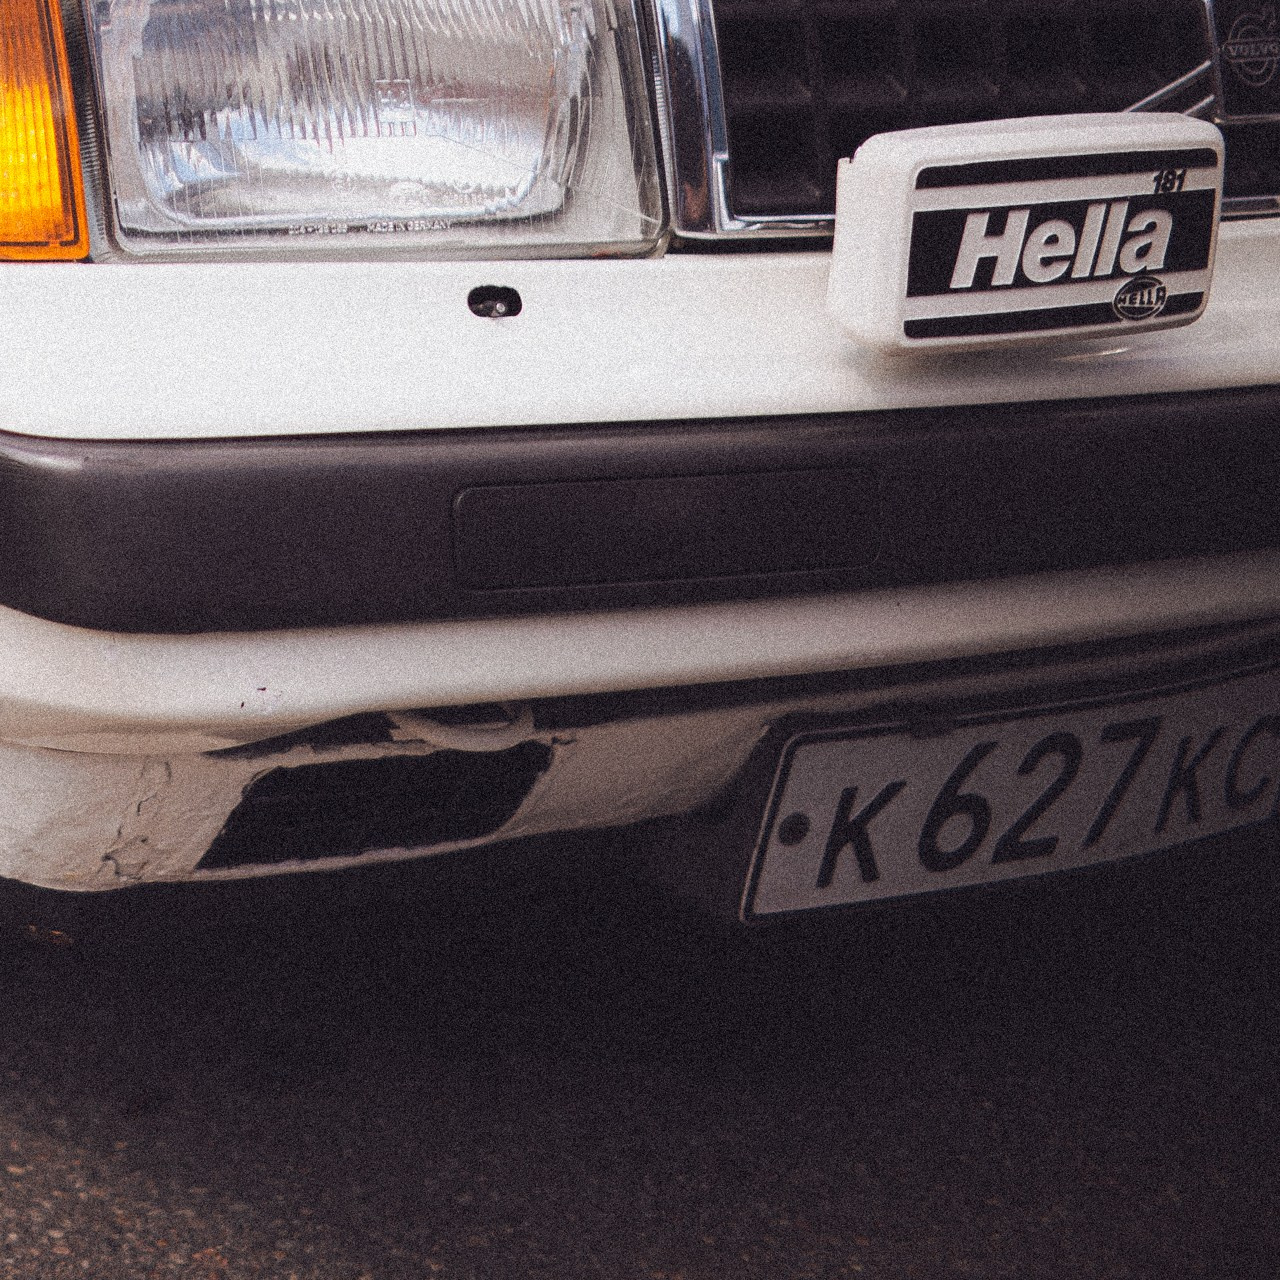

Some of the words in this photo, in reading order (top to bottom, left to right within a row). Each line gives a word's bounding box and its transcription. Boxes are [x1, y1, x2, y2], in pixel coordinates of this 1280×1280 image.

[1153, 168, 1188, 195] 181
[949, 200, 1173, 289] Hella
[1117, 285, 1167, 306] HELLA
